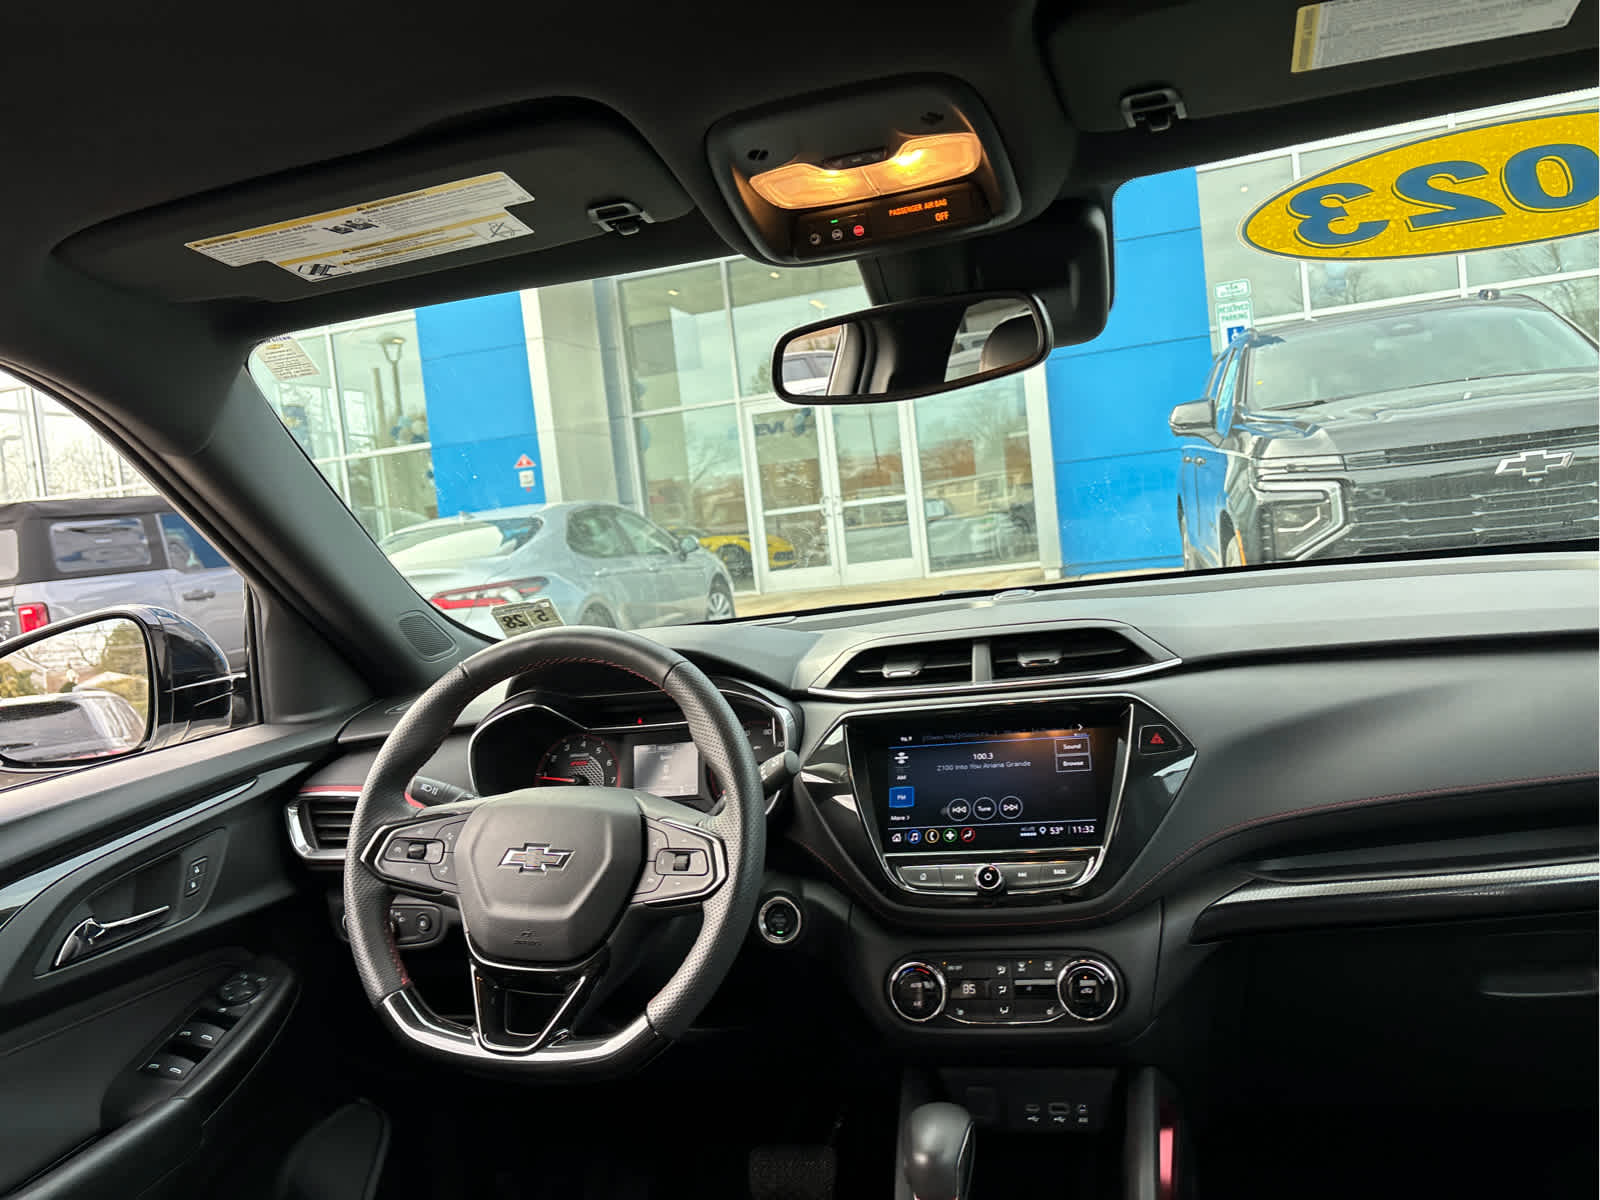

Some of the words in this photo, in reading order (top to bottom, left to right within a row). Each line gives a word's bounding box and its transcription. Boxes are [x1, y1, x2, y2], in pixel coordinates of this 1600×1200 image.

[889, 203, 922, 216] PASSENGER
[924, 201, 935, 209] AIR
[935, 198, 948, 207] BAG
[935, 211, 949, 221] OFF
[1221, 312, 1248, 321] PARKING
[972, 752, 994, 760] 100.3
[936, 764, 953, 772] Z100
[1071, 825, 1095, 834] 11:32
[962, 983, 976, 994] 85
